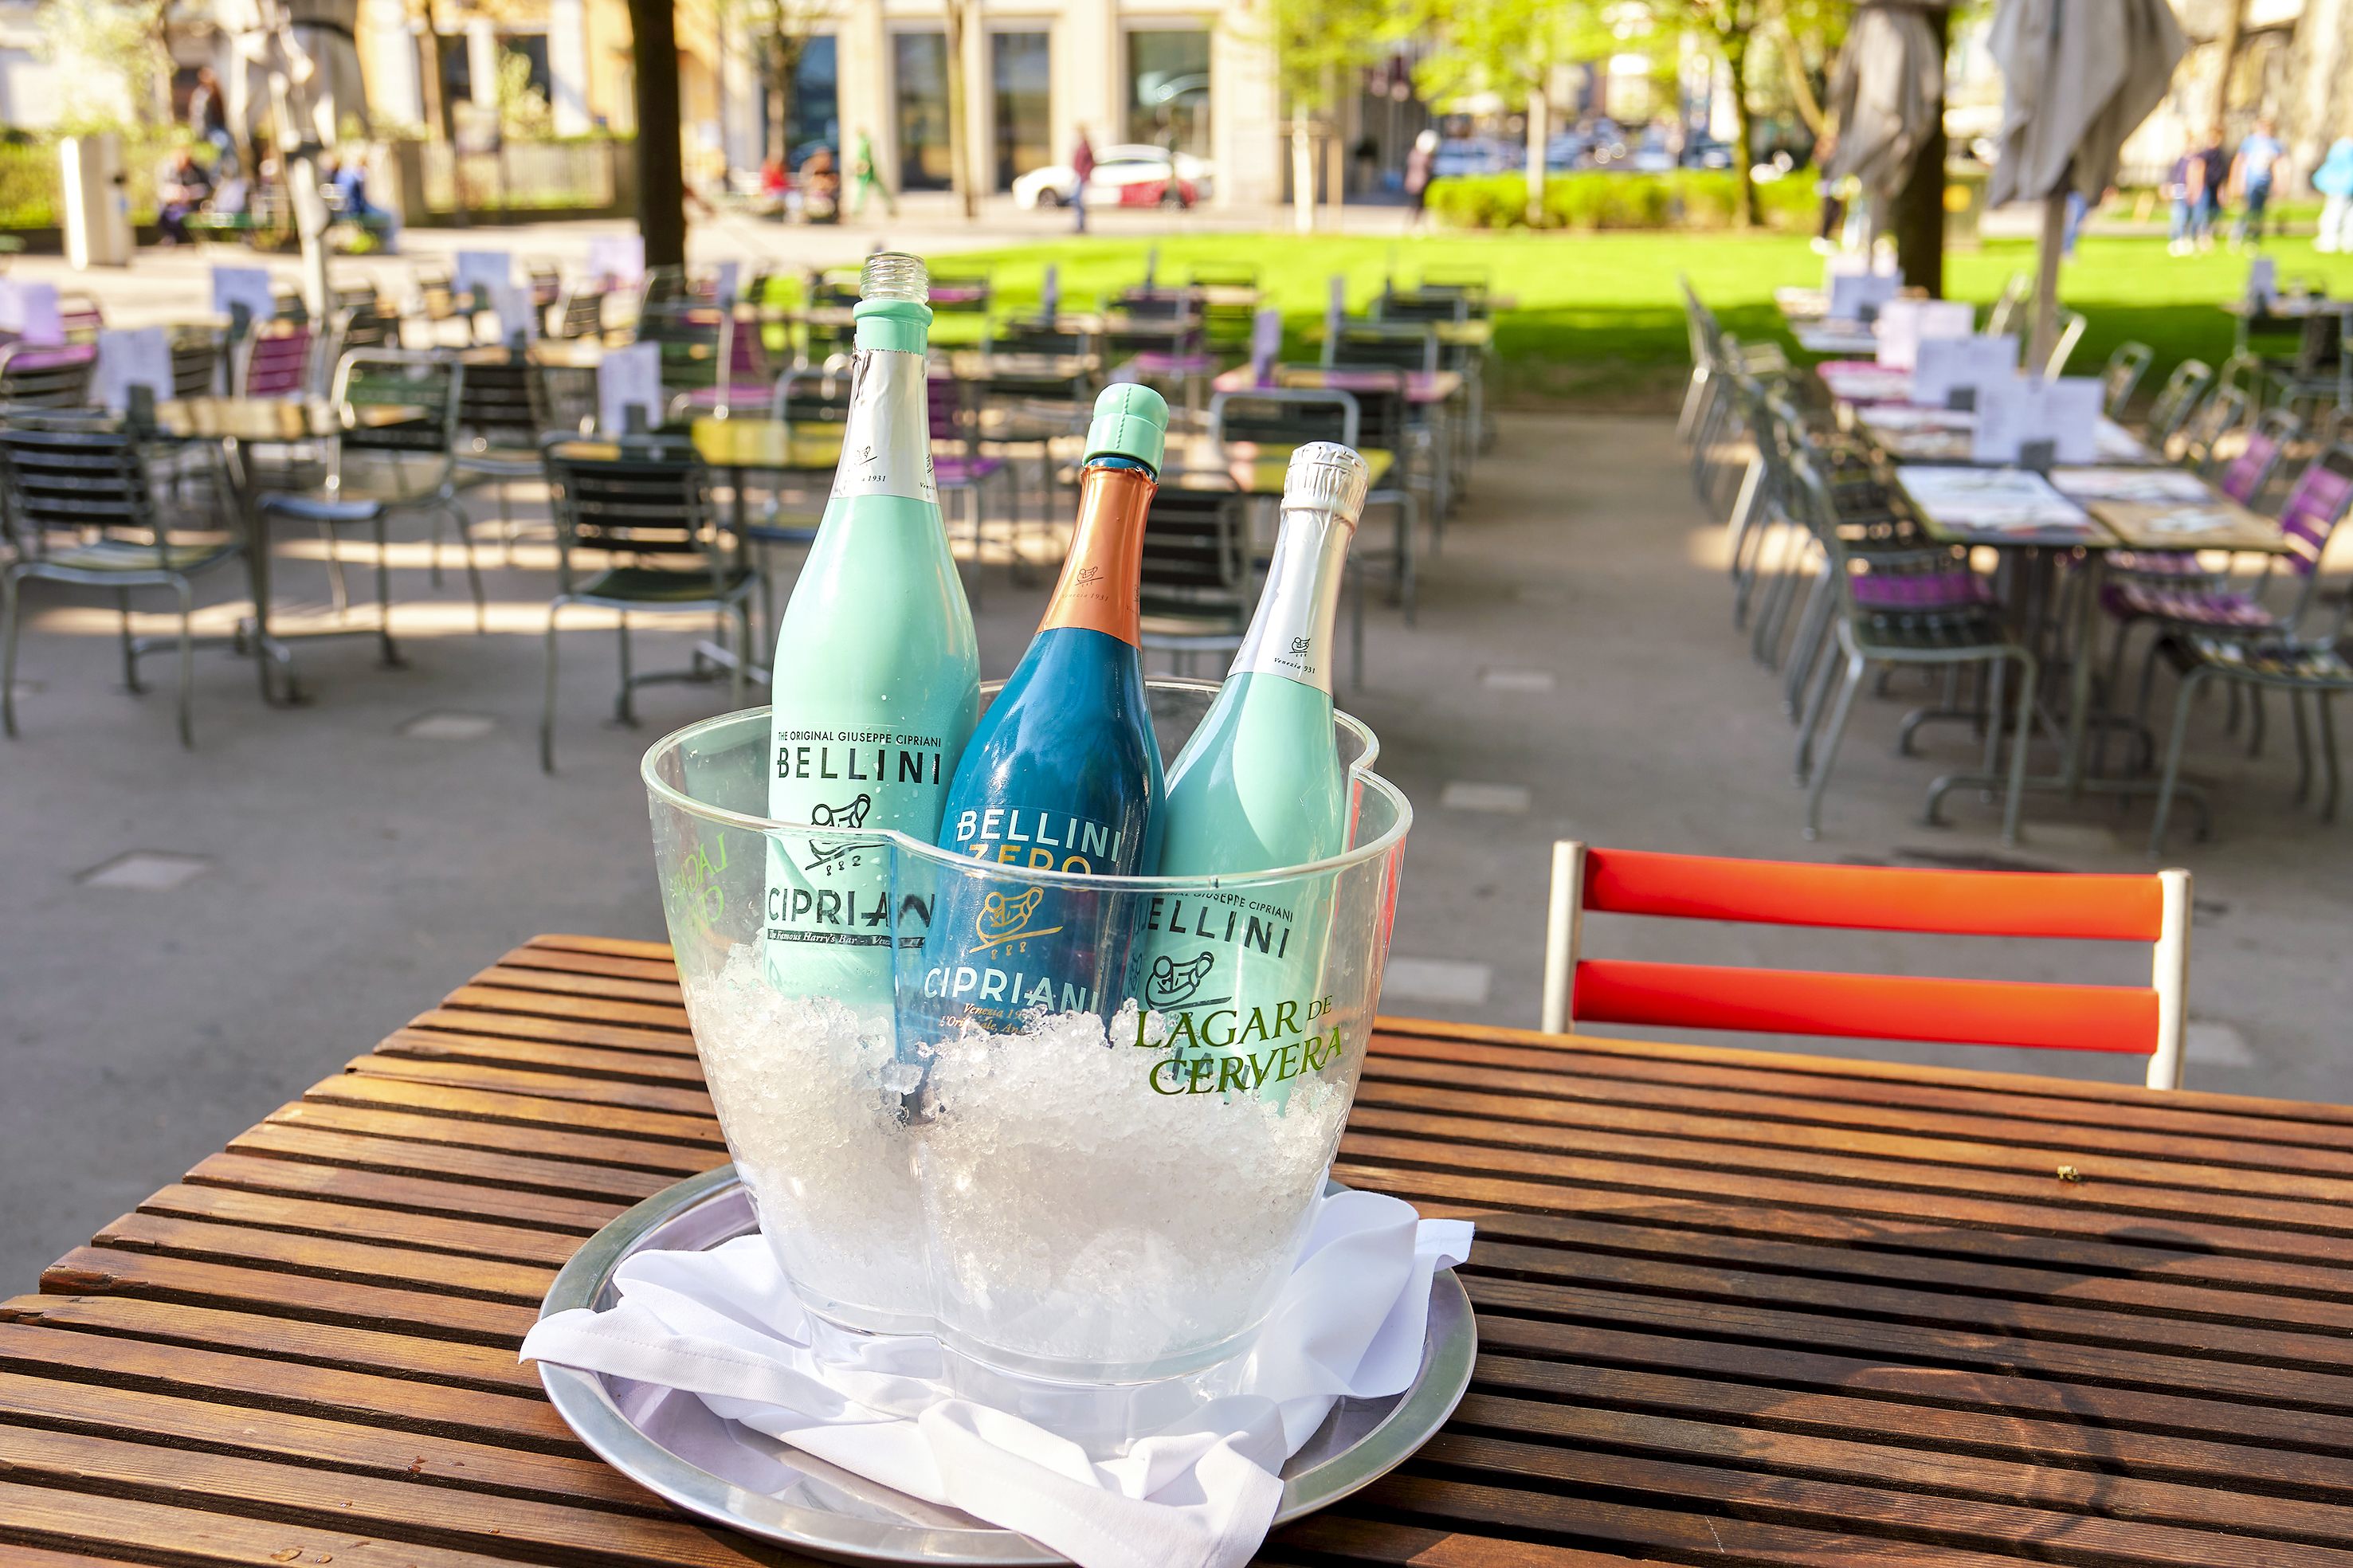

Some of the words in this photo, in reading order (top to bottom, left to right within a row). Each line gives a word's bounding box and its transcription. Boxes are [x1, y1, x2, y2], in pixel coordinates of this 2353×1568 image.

[1090, 593, 1109, 602] 1931
[1274, 657, 1301, 670] Venezia
[1303, 664, 1316, 675] 931
[778, 731, 788, 741] THE
[790, 731, 834, 742] ORIGINAL
[837, 731, 892, 744] GIUSEPPE
[896, 734, 942, 748] CIPRIANI
[776, 747, 941, 785] BELLINI
[956, 808, 1122, 863] BELLINI
[767, 887, 935, 929] CIPRIAN
[1249, 900, 1294, 923] CIPRIANI
[777, 930, 802, 941] Famous
[803, 931, 836, 945] Harry's
[838, 934, 857, 944] Bar
[1147, 896, 1291, 959] ELLINI
[924, 966, 1099, 1014] CIPRIANI
[963, 1002, 1004, 1017] Venezia
[1006, 1009, 1022, 1020] 19
[1132, 1000, 1304, 1049] LAGAR
[1307, 994, 1333, 1021] DE
[1148, 1025, 1343, 1096] CERVERA
